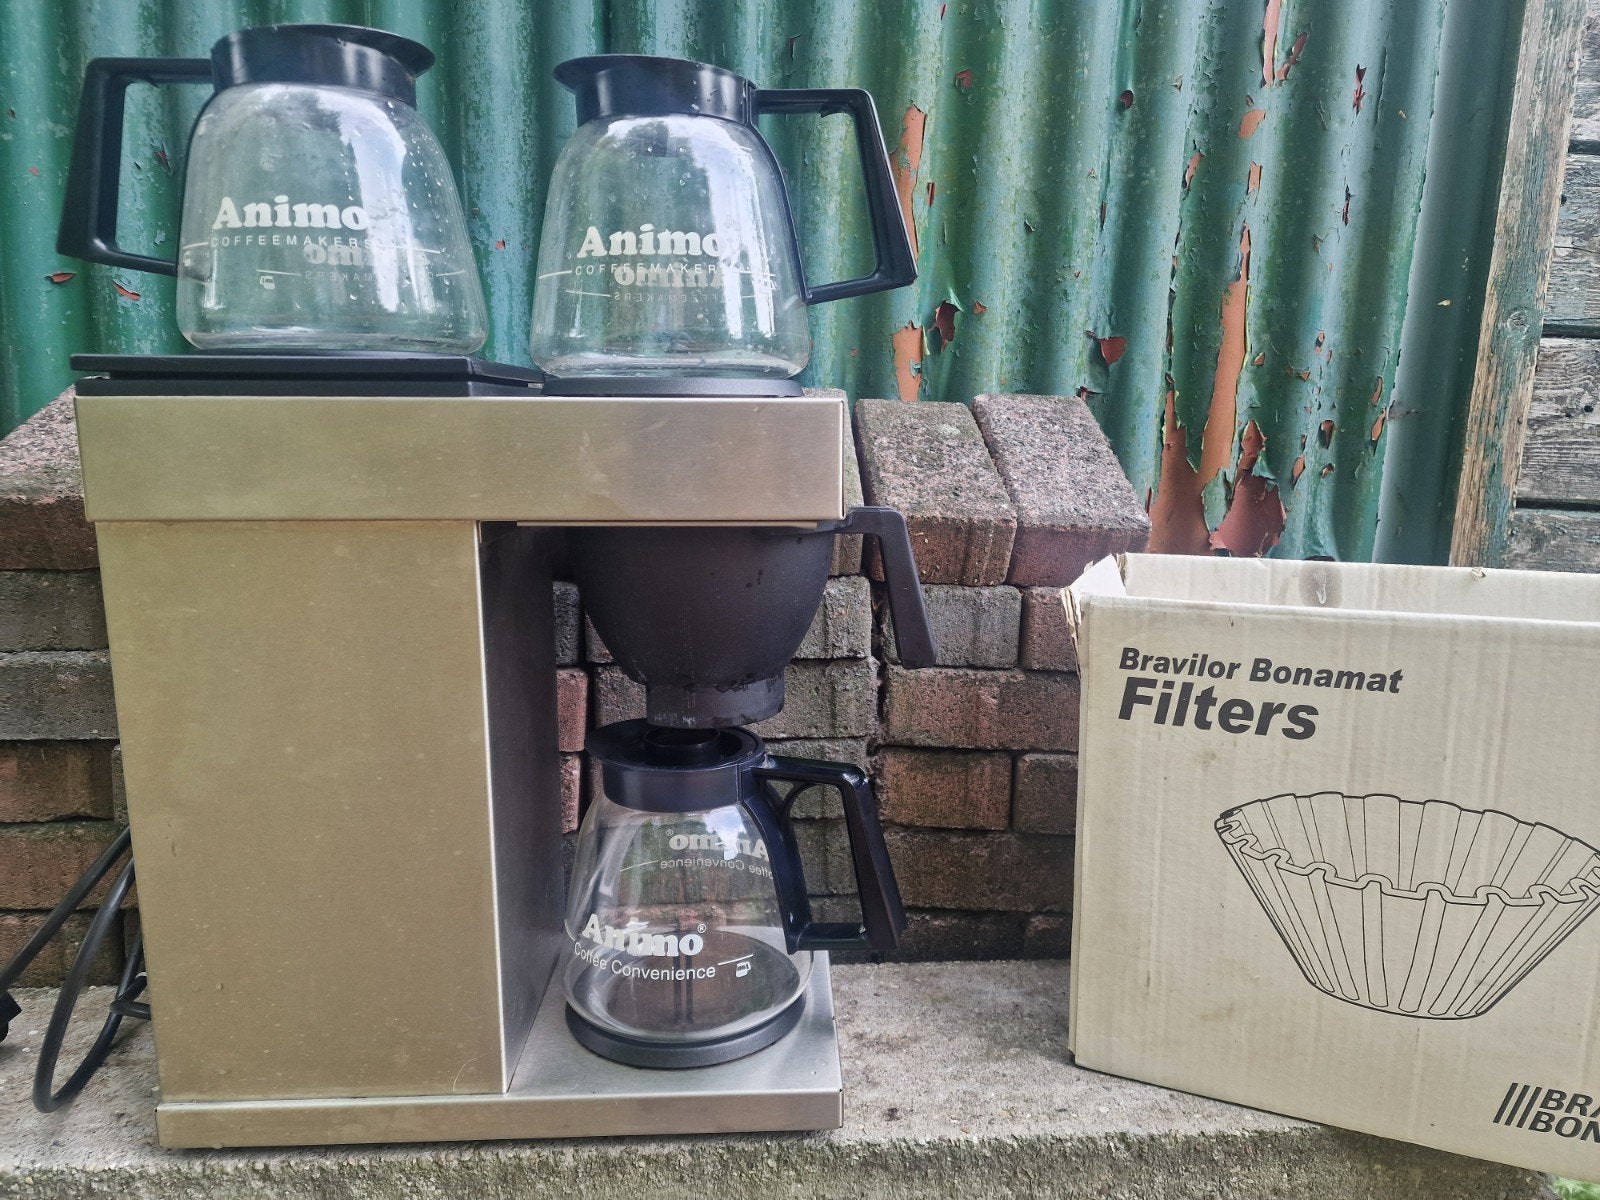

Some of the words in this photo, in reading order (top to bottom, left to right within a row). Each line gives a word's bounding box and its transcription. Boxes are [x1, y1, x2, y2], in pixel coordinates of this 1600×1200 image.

[212, 195, 370, 231] Animo
[210, 234, 373, 249] COFFEEMAKERS
[1119, 647, 1242, 679] Bravilor
[1249, 657, 1403, 694] Bonamat
[1118, 676, 1319, 740] Filters
[574, 942, 607, 971] Coffee
[611, 959, 716, 981] Convenience
